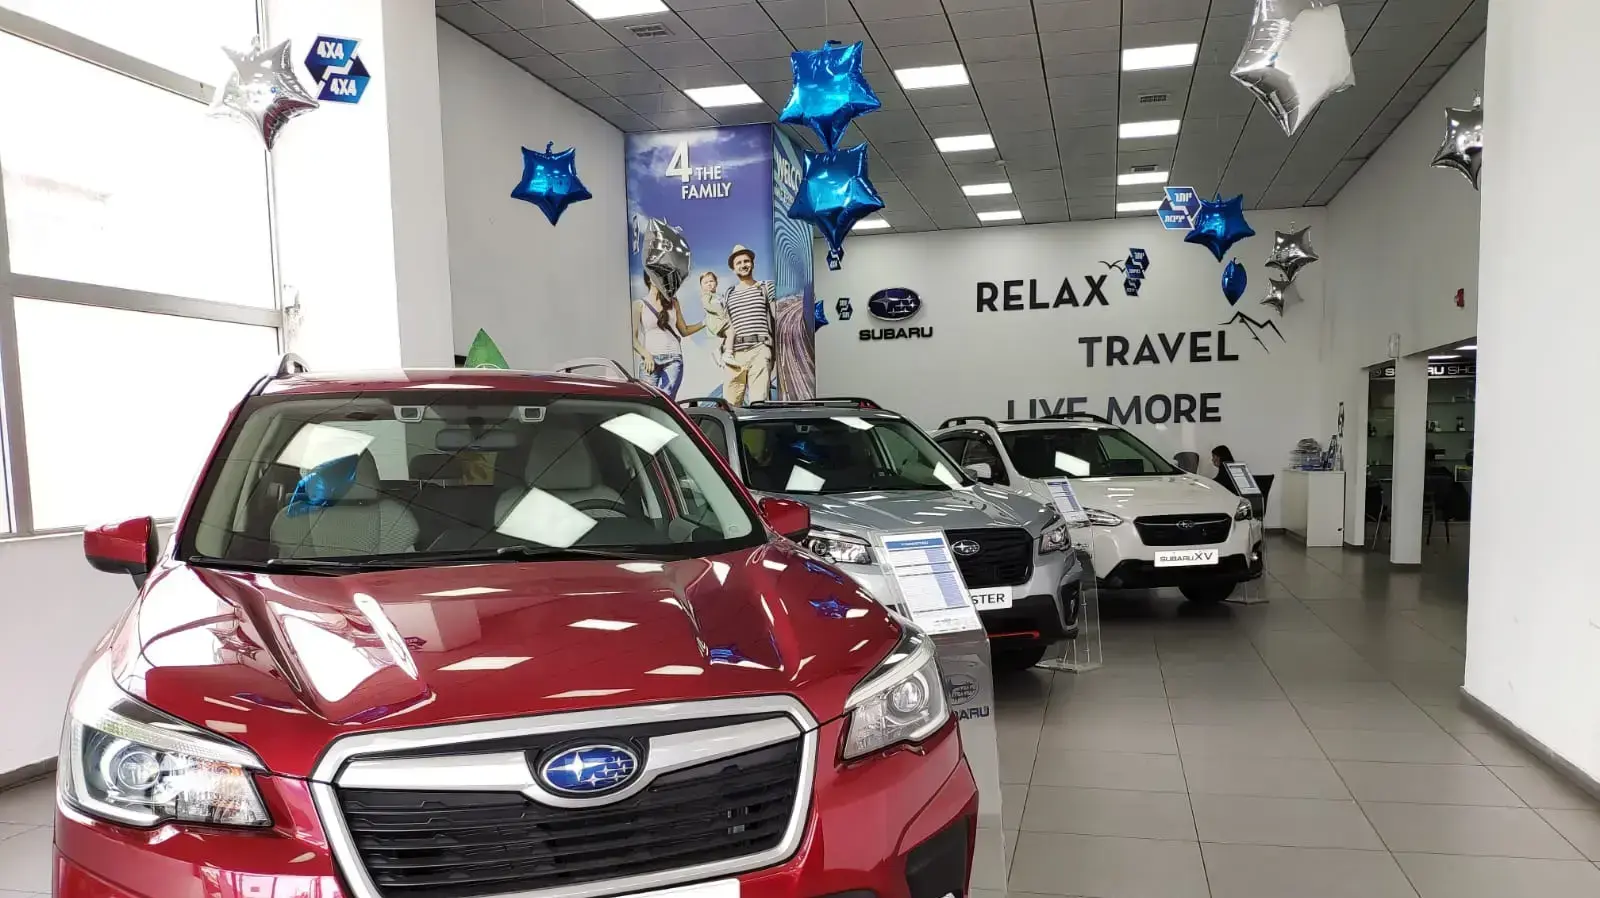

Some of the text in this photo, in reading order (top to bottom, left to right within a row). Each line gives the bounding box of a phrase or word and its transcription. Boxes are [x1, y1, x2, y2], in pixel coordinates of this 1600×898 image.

[316, 41, 344, 59] 4X4
[330, 78, 357, 96] 4X4
[665, 140, 722, 183] 4 THE
[681, 182, 732, 200] FAMILY
[1174, 192, 1193, 203] יותר
[976, 274, 1110, 313] RELAX
[858, 326, 934, 341] SUBARU
[1078, 330, 1239, 368] TRAVEL
[1106, 392, 1223, 425] MORE
[1194, 551, 1213, 561] XV
[970, 593, 1005, 605] STER
